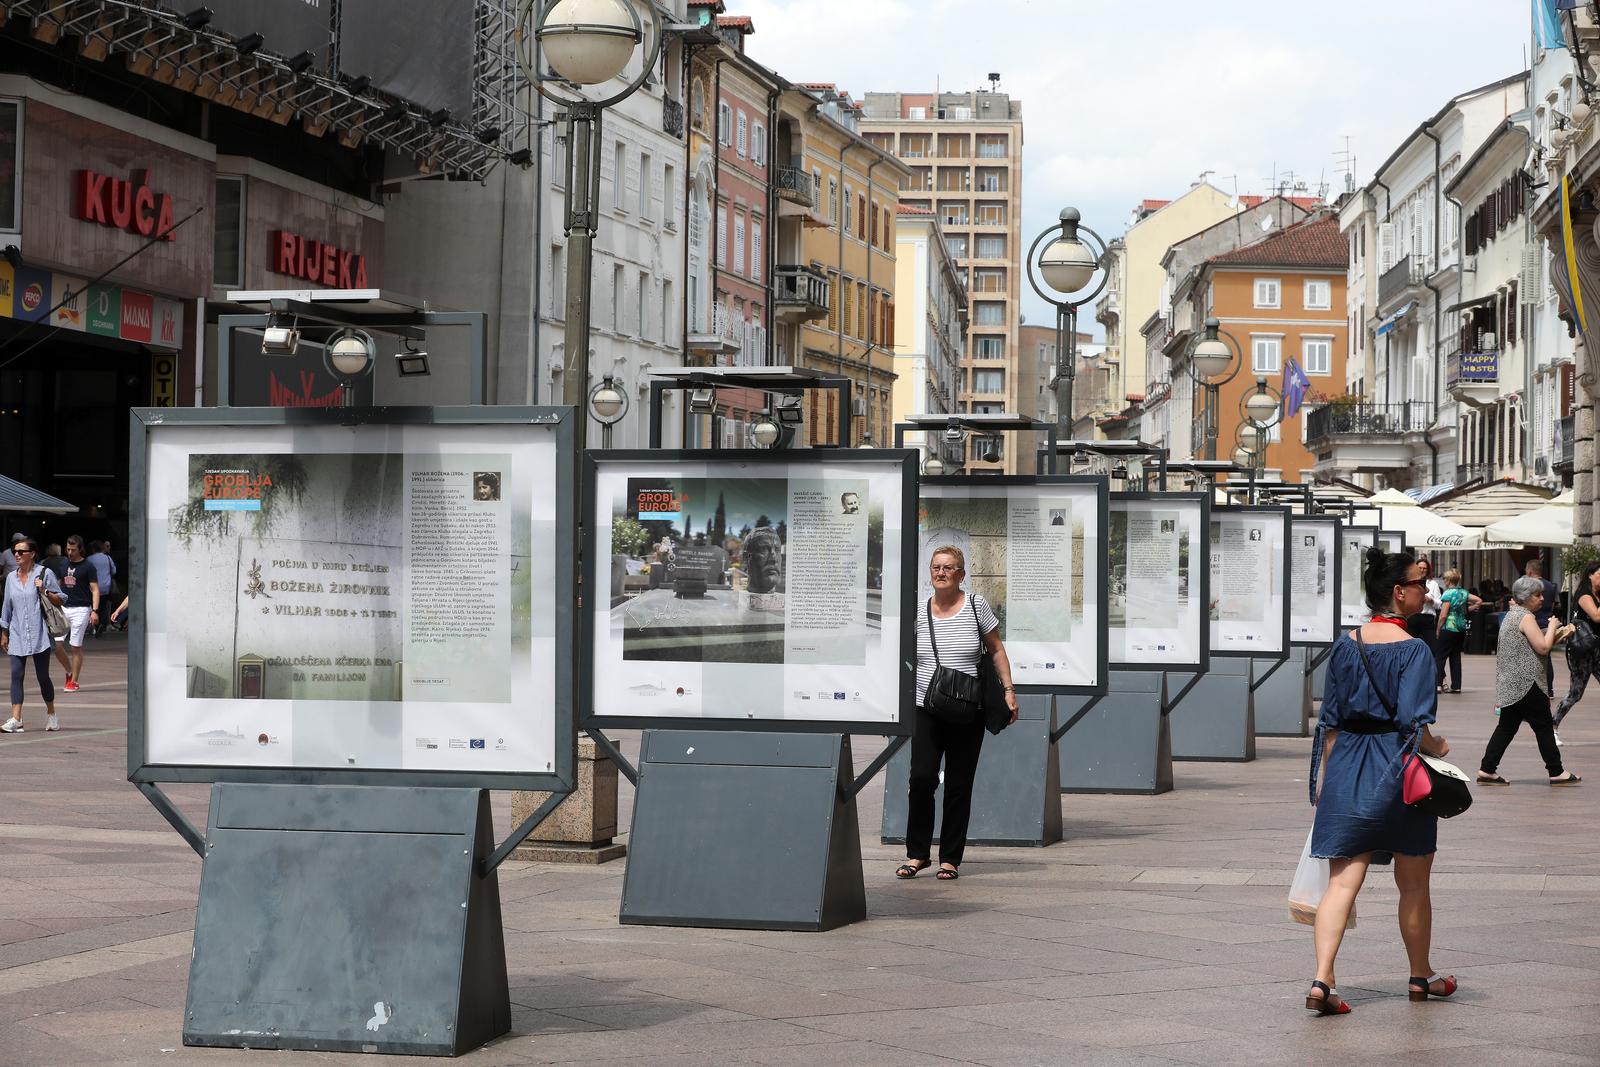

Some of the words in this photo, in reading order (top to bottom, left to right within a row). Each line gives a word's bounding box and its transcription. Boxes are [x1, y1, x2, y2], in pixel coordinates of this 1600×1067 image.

[86, 160, 176, 242] KUĆA
[280, 231, 368, 289] RIJEKA
[124, 304, 150, 328] MANA
[204, 474, 272, 486] GROBLJA
[204, 487, 262, 498] EUROPE
[639, 502, 682, 512] EUROPE
[272, 559, 307, 570] POČIVA
[312, 561, 318, 570] U
[322, 561, 347, 571] MIRU
[352, 560, 389, 573] BOŽJEM
[270, 580, 324, 593] BOŽENA
[329, 582, 390, 596] ŽIROVNIK
[274, 605, 322, 617] VILHAR
